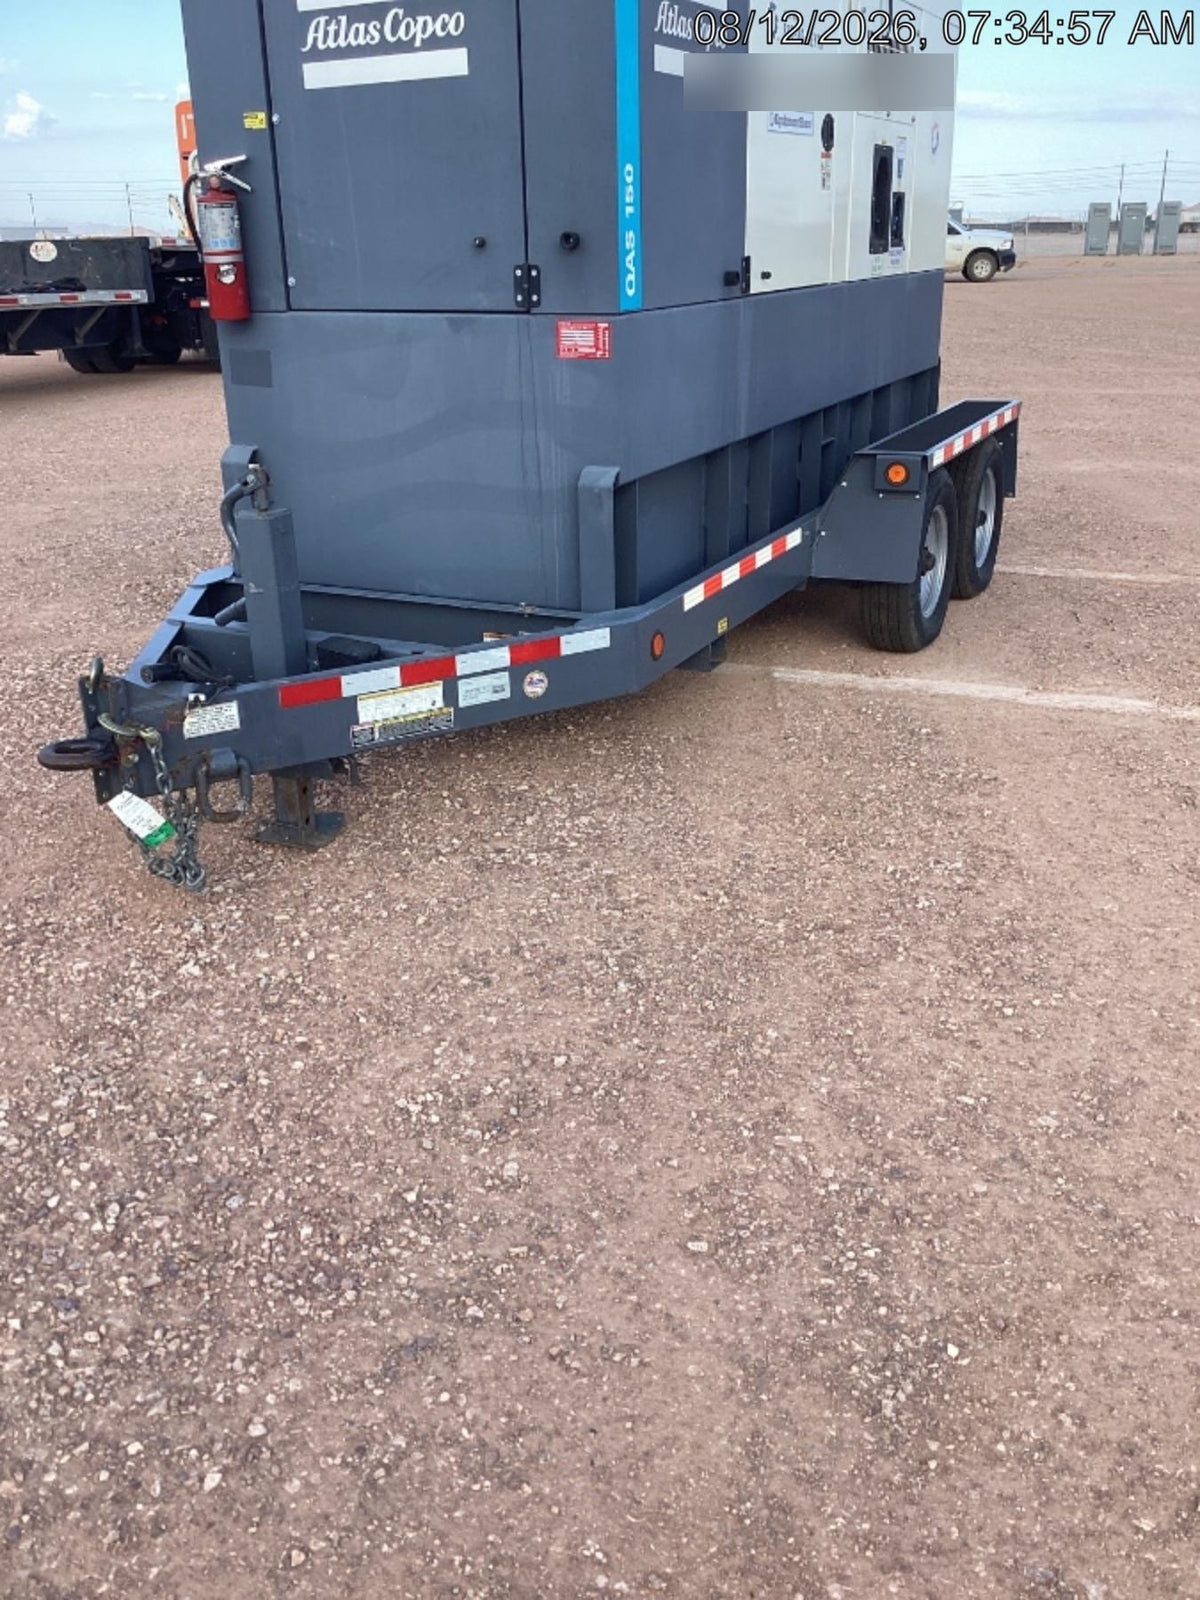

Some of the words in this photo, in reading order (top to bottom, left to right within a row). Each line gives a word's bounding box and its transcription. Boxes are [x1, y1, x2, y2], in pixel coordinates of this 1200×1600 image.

[301, 15, 381, 52] Atlas
[383, 8, 465, 47] Copco
[623, 163, 635, 219] 150
[624, 229, 636, 297] QAS
